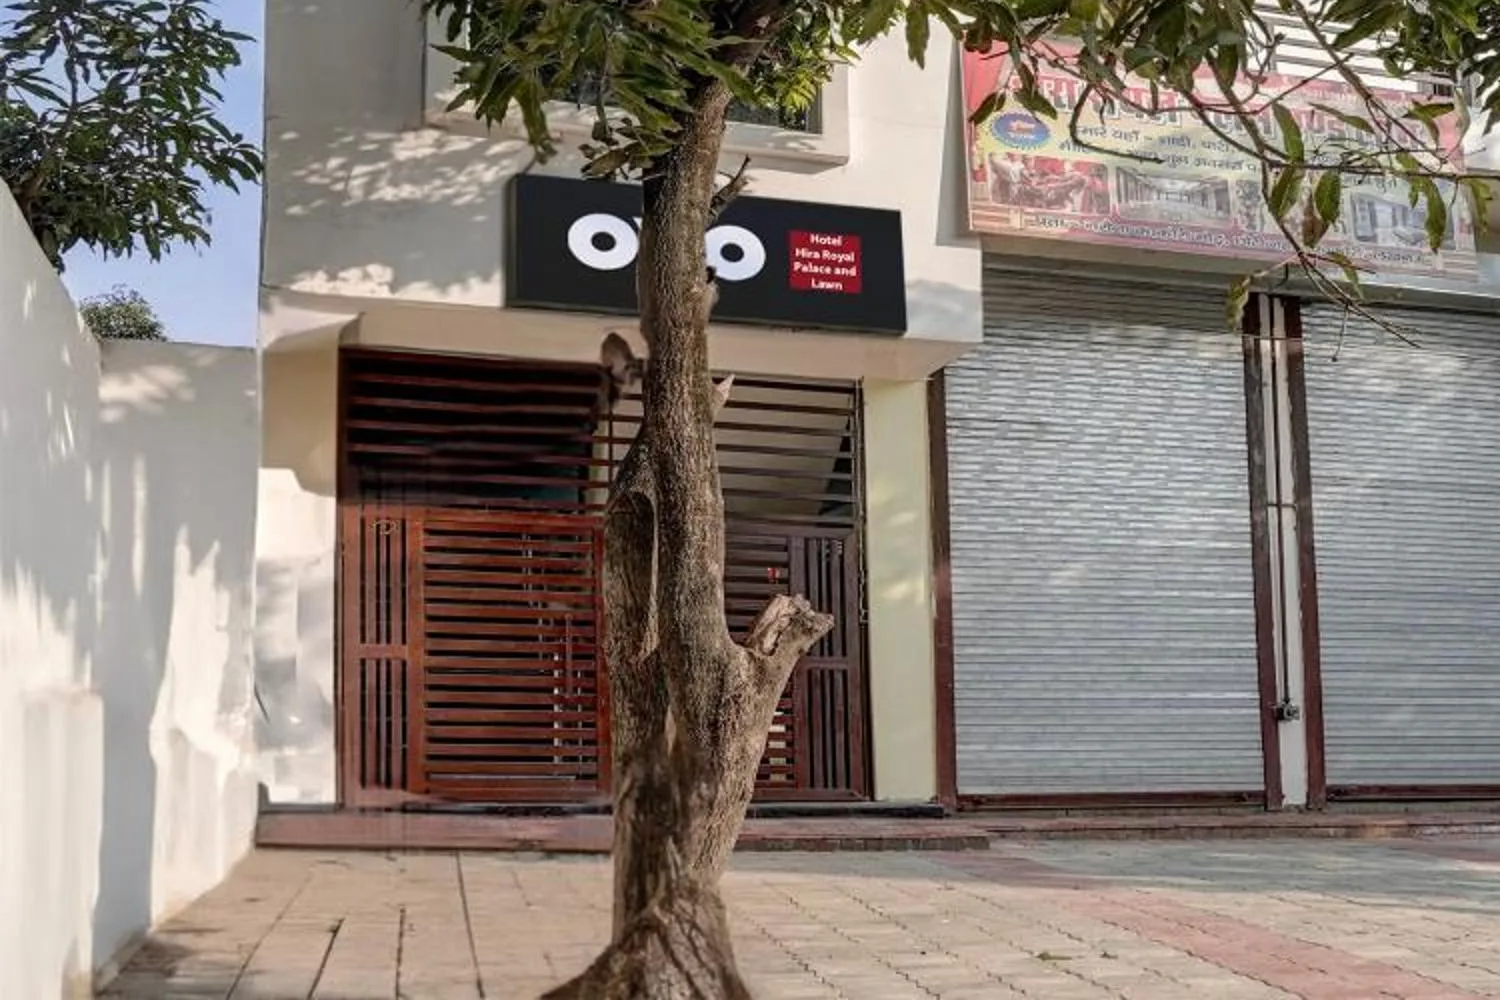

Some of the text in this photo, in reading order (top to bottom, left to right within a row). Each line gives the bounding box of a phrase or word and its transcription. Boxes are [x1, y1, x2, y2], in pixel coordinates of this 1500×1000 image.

[568, 213, 766, 281] OO
[810, 233, 843, 247] Hotel
[795, 248, 855, 263] Hira Royal
[793, 261, 857, 277] Palace and
[811, 277, 843, 291] Lawn
